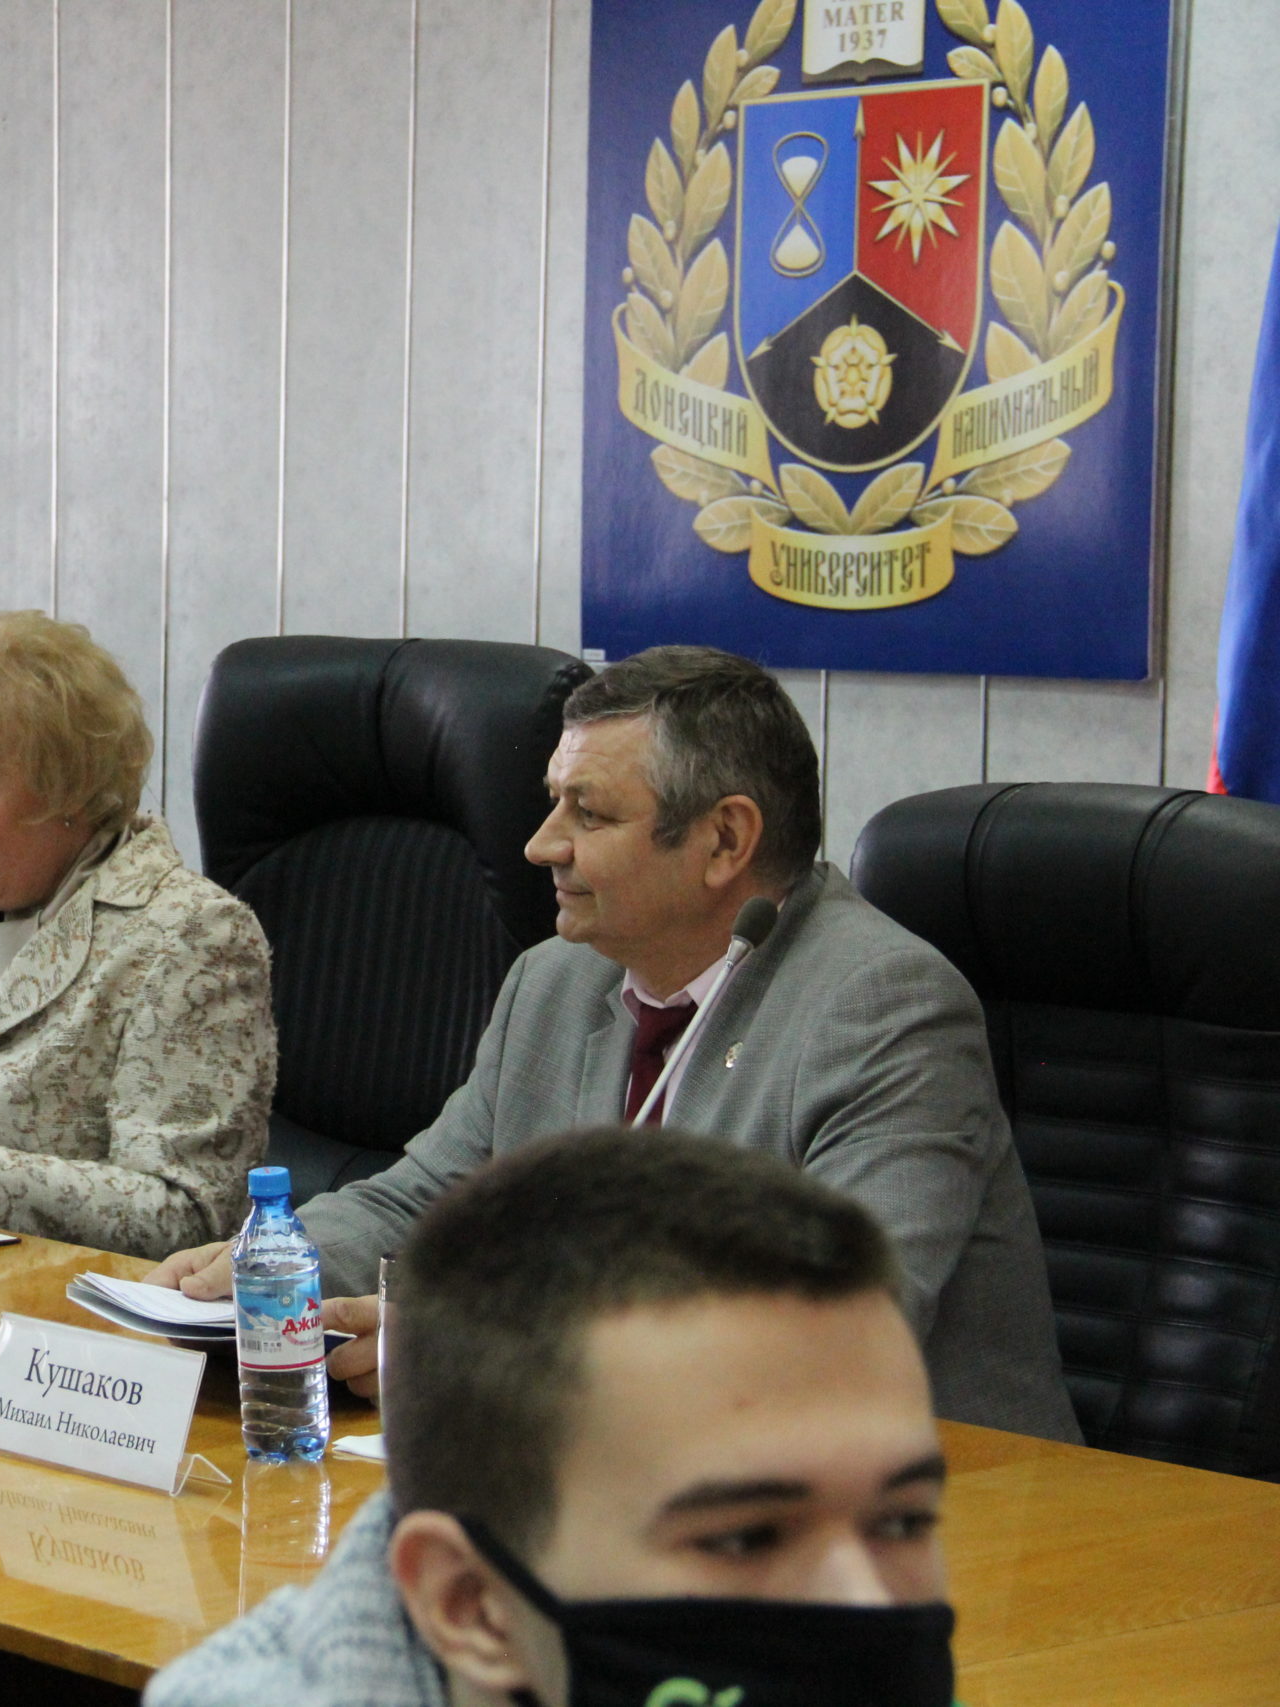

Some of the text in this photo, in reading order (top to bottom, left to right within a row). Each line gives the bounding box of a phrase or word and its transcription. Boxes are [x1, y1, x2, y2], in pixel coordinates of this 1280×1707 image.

[823, 1, 905, 28] MATER
[838, 28, 888, 53] 1937
[24, 1347, 144, 1406] Кушаков
[55, 1410, 158, 1455] Николаевич
